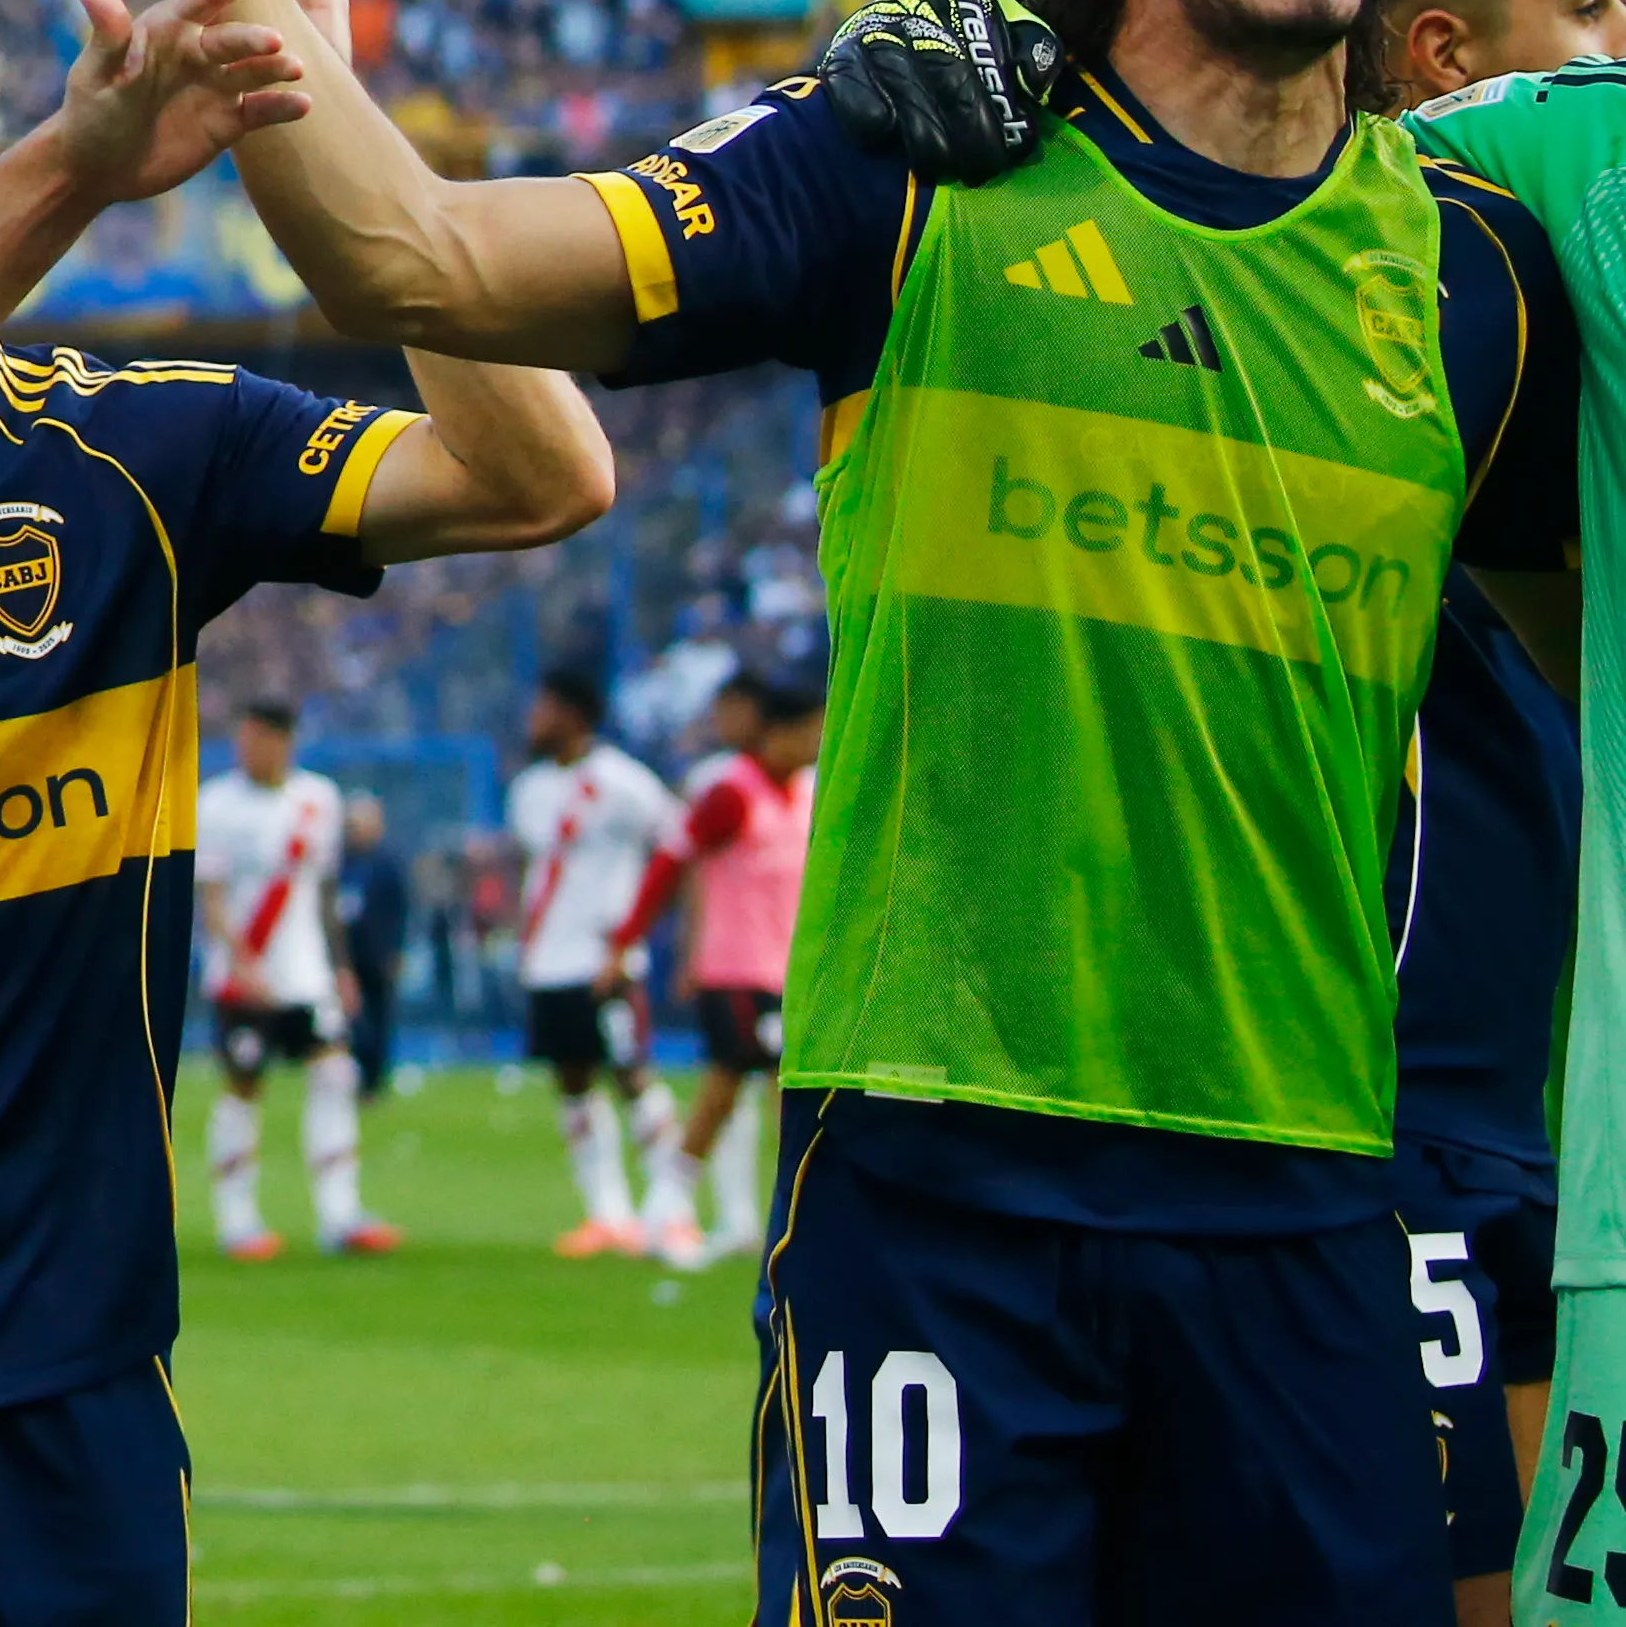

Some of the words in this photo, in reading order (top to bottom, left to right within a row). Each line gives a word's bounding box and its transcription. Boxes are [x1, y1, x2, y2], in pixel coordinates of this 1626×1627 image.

[958, 1, 1028, 149] reusch
[988, 455, 1411, 613] betsson
[1409, 1233, 1484, 1388] 5
[812, 1350, 961, 1539] 10
